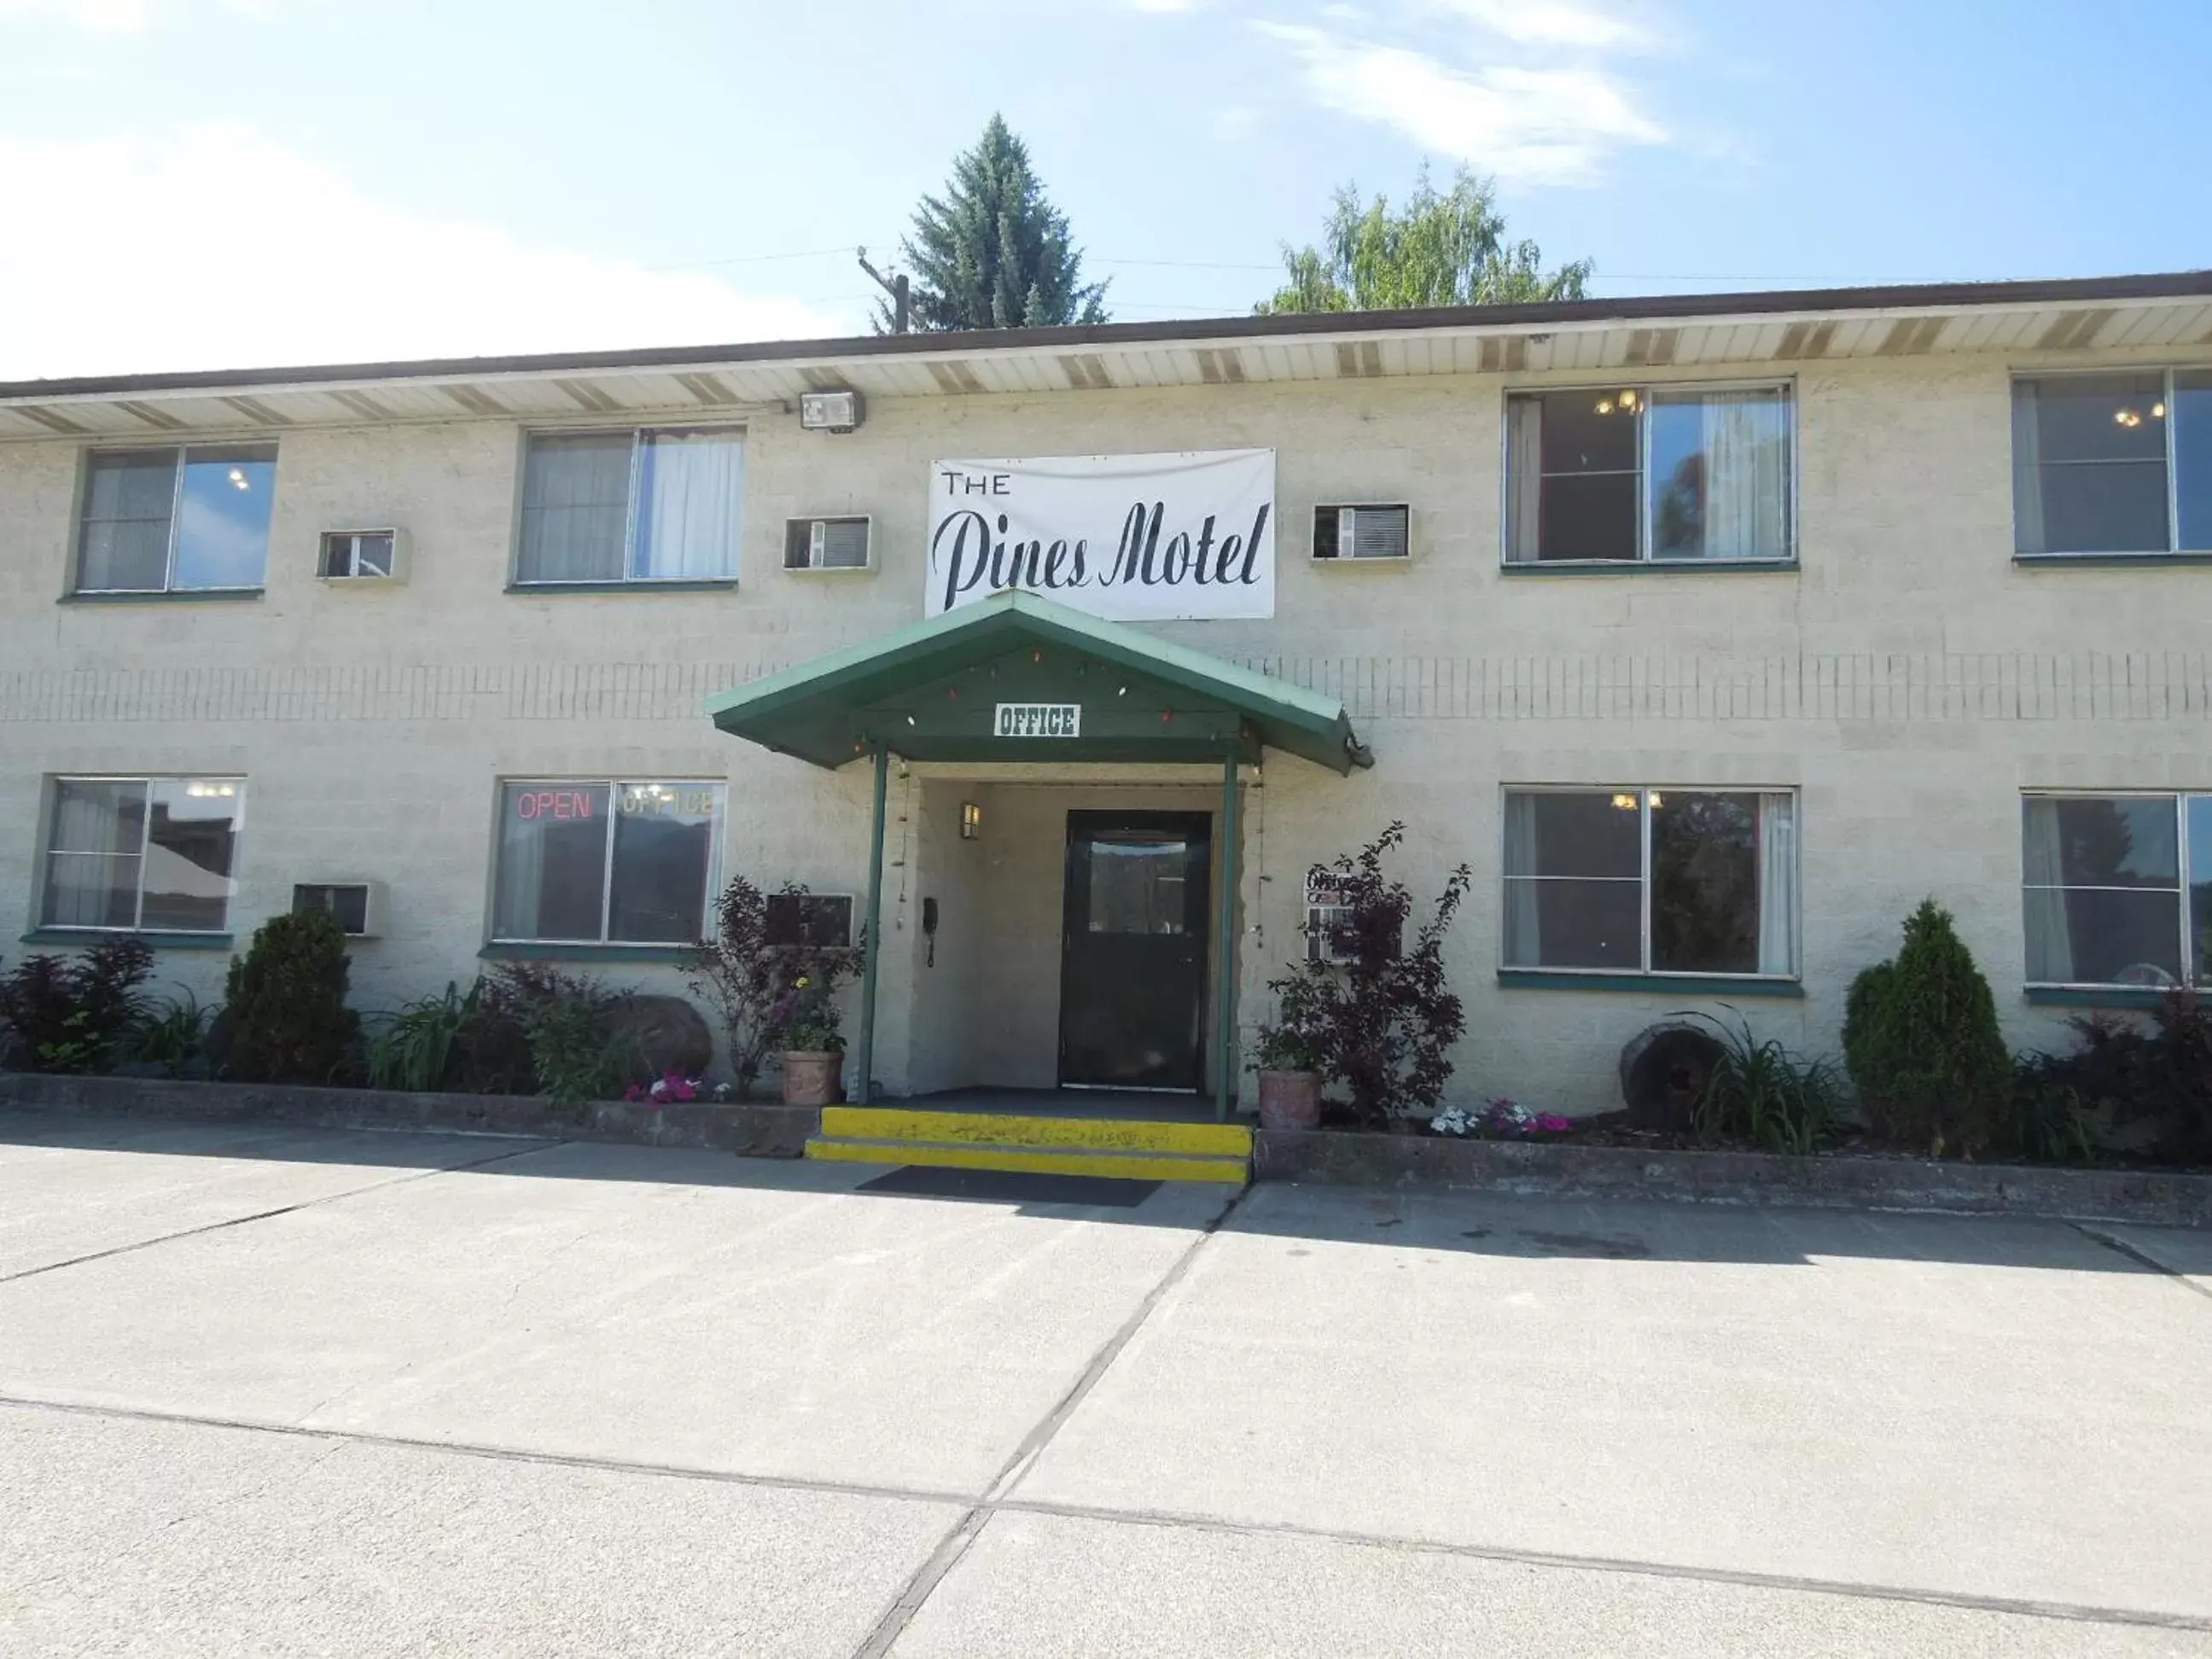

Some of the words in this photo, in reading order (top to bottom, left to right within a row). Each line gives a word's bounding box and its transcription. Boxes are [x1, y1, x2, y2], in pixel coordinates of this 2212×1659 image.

[941, 472, 1011, 496] THE
[931, 509, 1092, 612] Pines
[1097, 501, 1271, 587] Motel
[1000, 707, 1075, 736] OFFICE
[518, 792, 593, 819] OPEN
